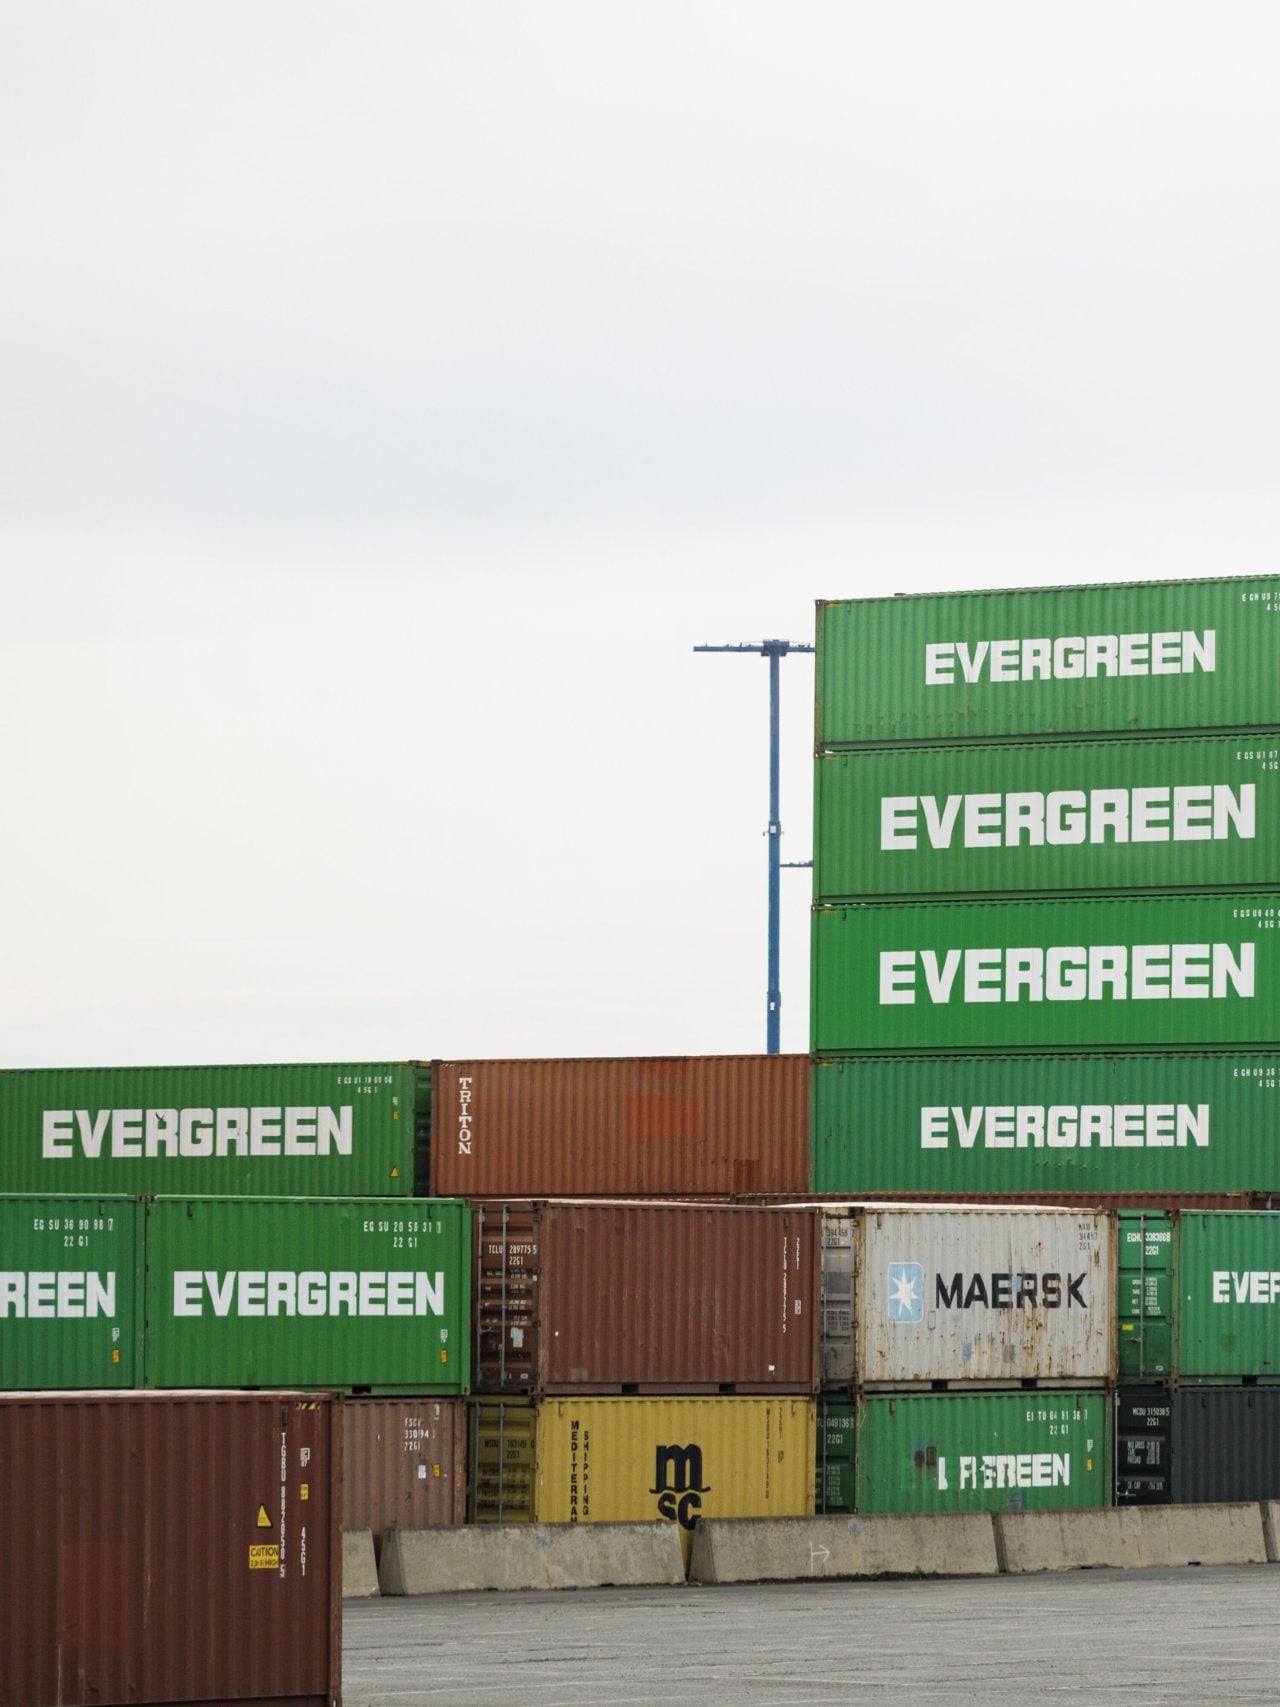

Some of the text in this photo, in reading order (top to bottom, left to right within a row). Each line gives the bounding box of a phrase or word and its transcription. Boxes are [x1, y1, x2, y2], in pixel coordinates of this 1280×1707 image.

[925, 629, 1216, 686] EVERGREEN
[880, 783, 1256, 851] EVERGREEN
[879, 942, 1255, 1005] EVERGREEN
[42, 1105, 353, 1158] EVERGREEN
[457, 1076, 473, 1155] TRITON
[920, 1103, 1210, 1149] EVERGREEN
[0, 1271, 116, 1318] REEN
[173, 1270, 444, 1317] EVERGREEN
[936, 1273, 1088, 1309] MAERSK
